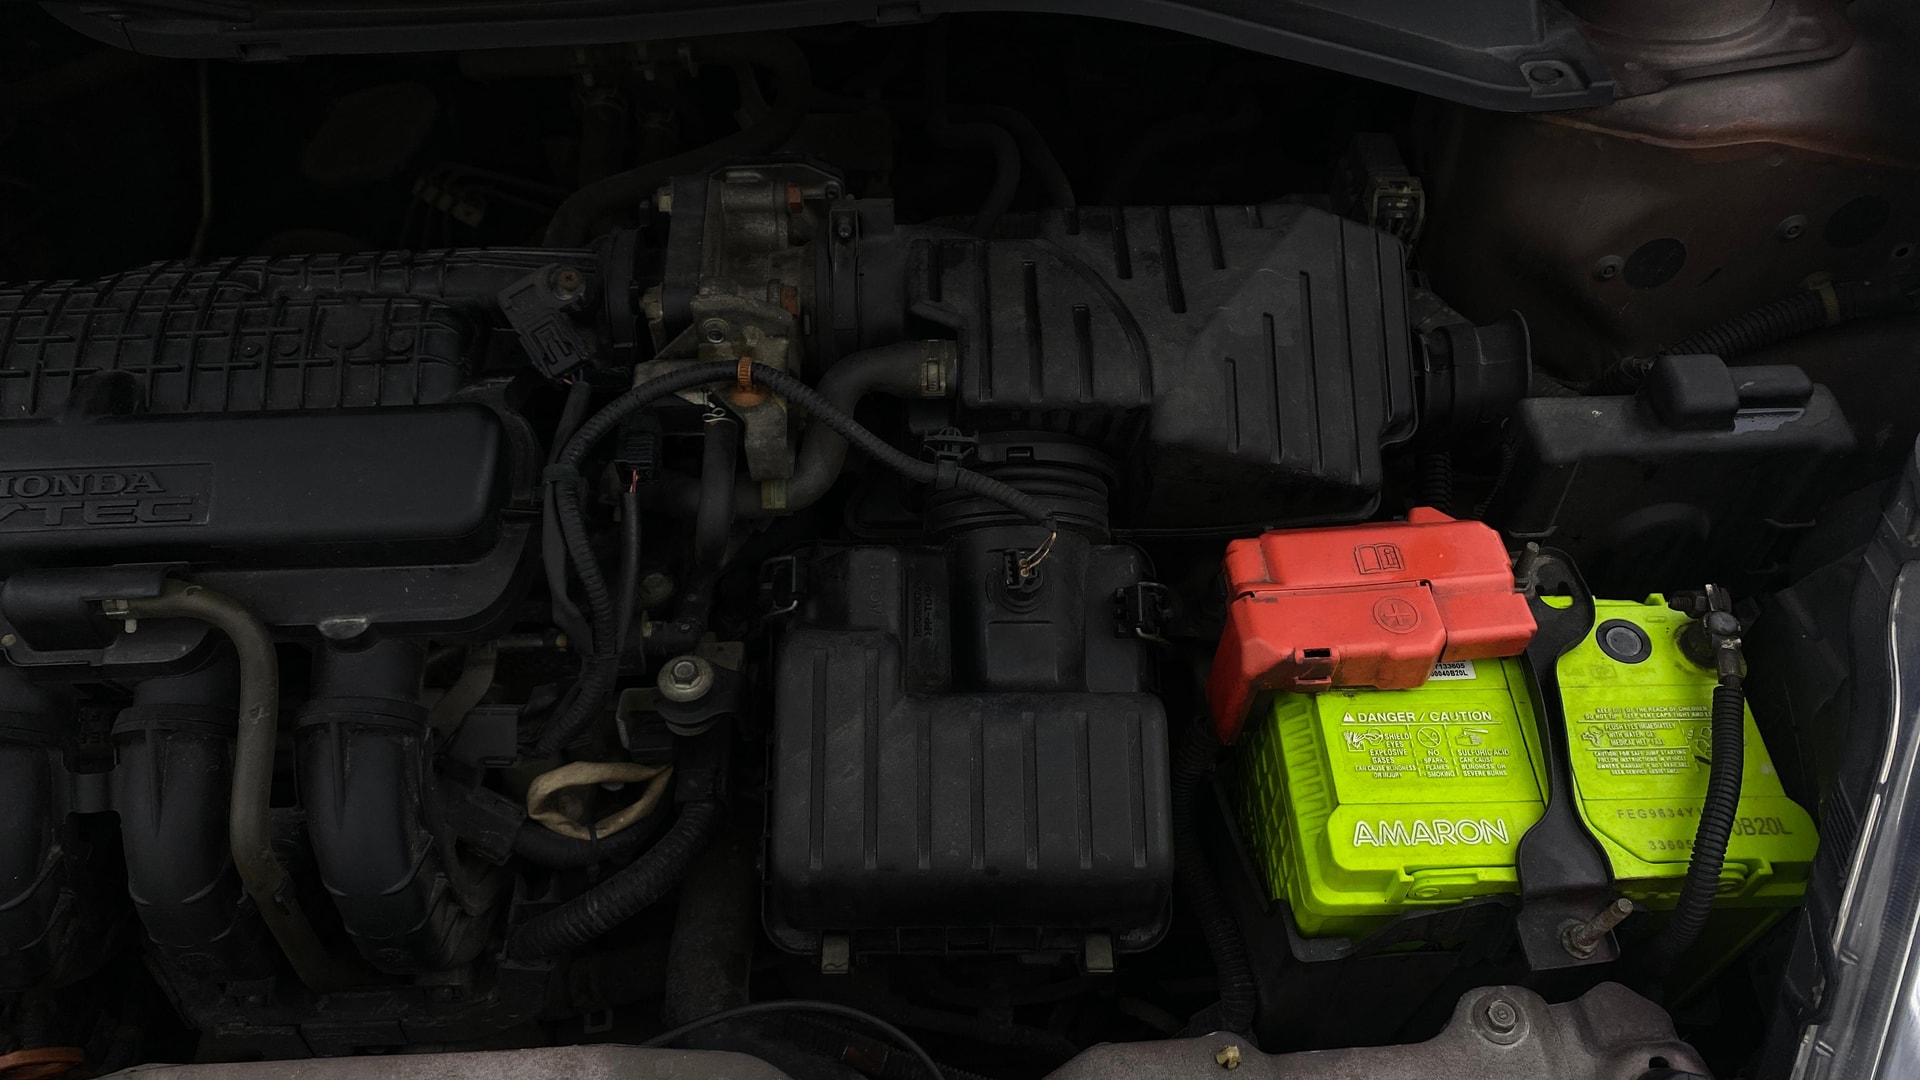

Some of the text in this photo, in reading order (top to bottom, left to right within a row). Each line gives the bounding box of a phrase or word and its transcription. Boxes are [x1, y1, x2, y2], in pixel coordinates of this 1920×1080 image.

[1357, 711, 1416, 722] DANGER
[1429, 711, 1492, 722] CAUTION
[1386, 740, 1404, 748] EYES
[1370, 748, 1408, 756] EXPLOSIVE
[1493, 748, 1510, 756] ACID
[1428, 770, 1456, 778] SMOKING
[1353, 818, 1510, 847] AMARON
